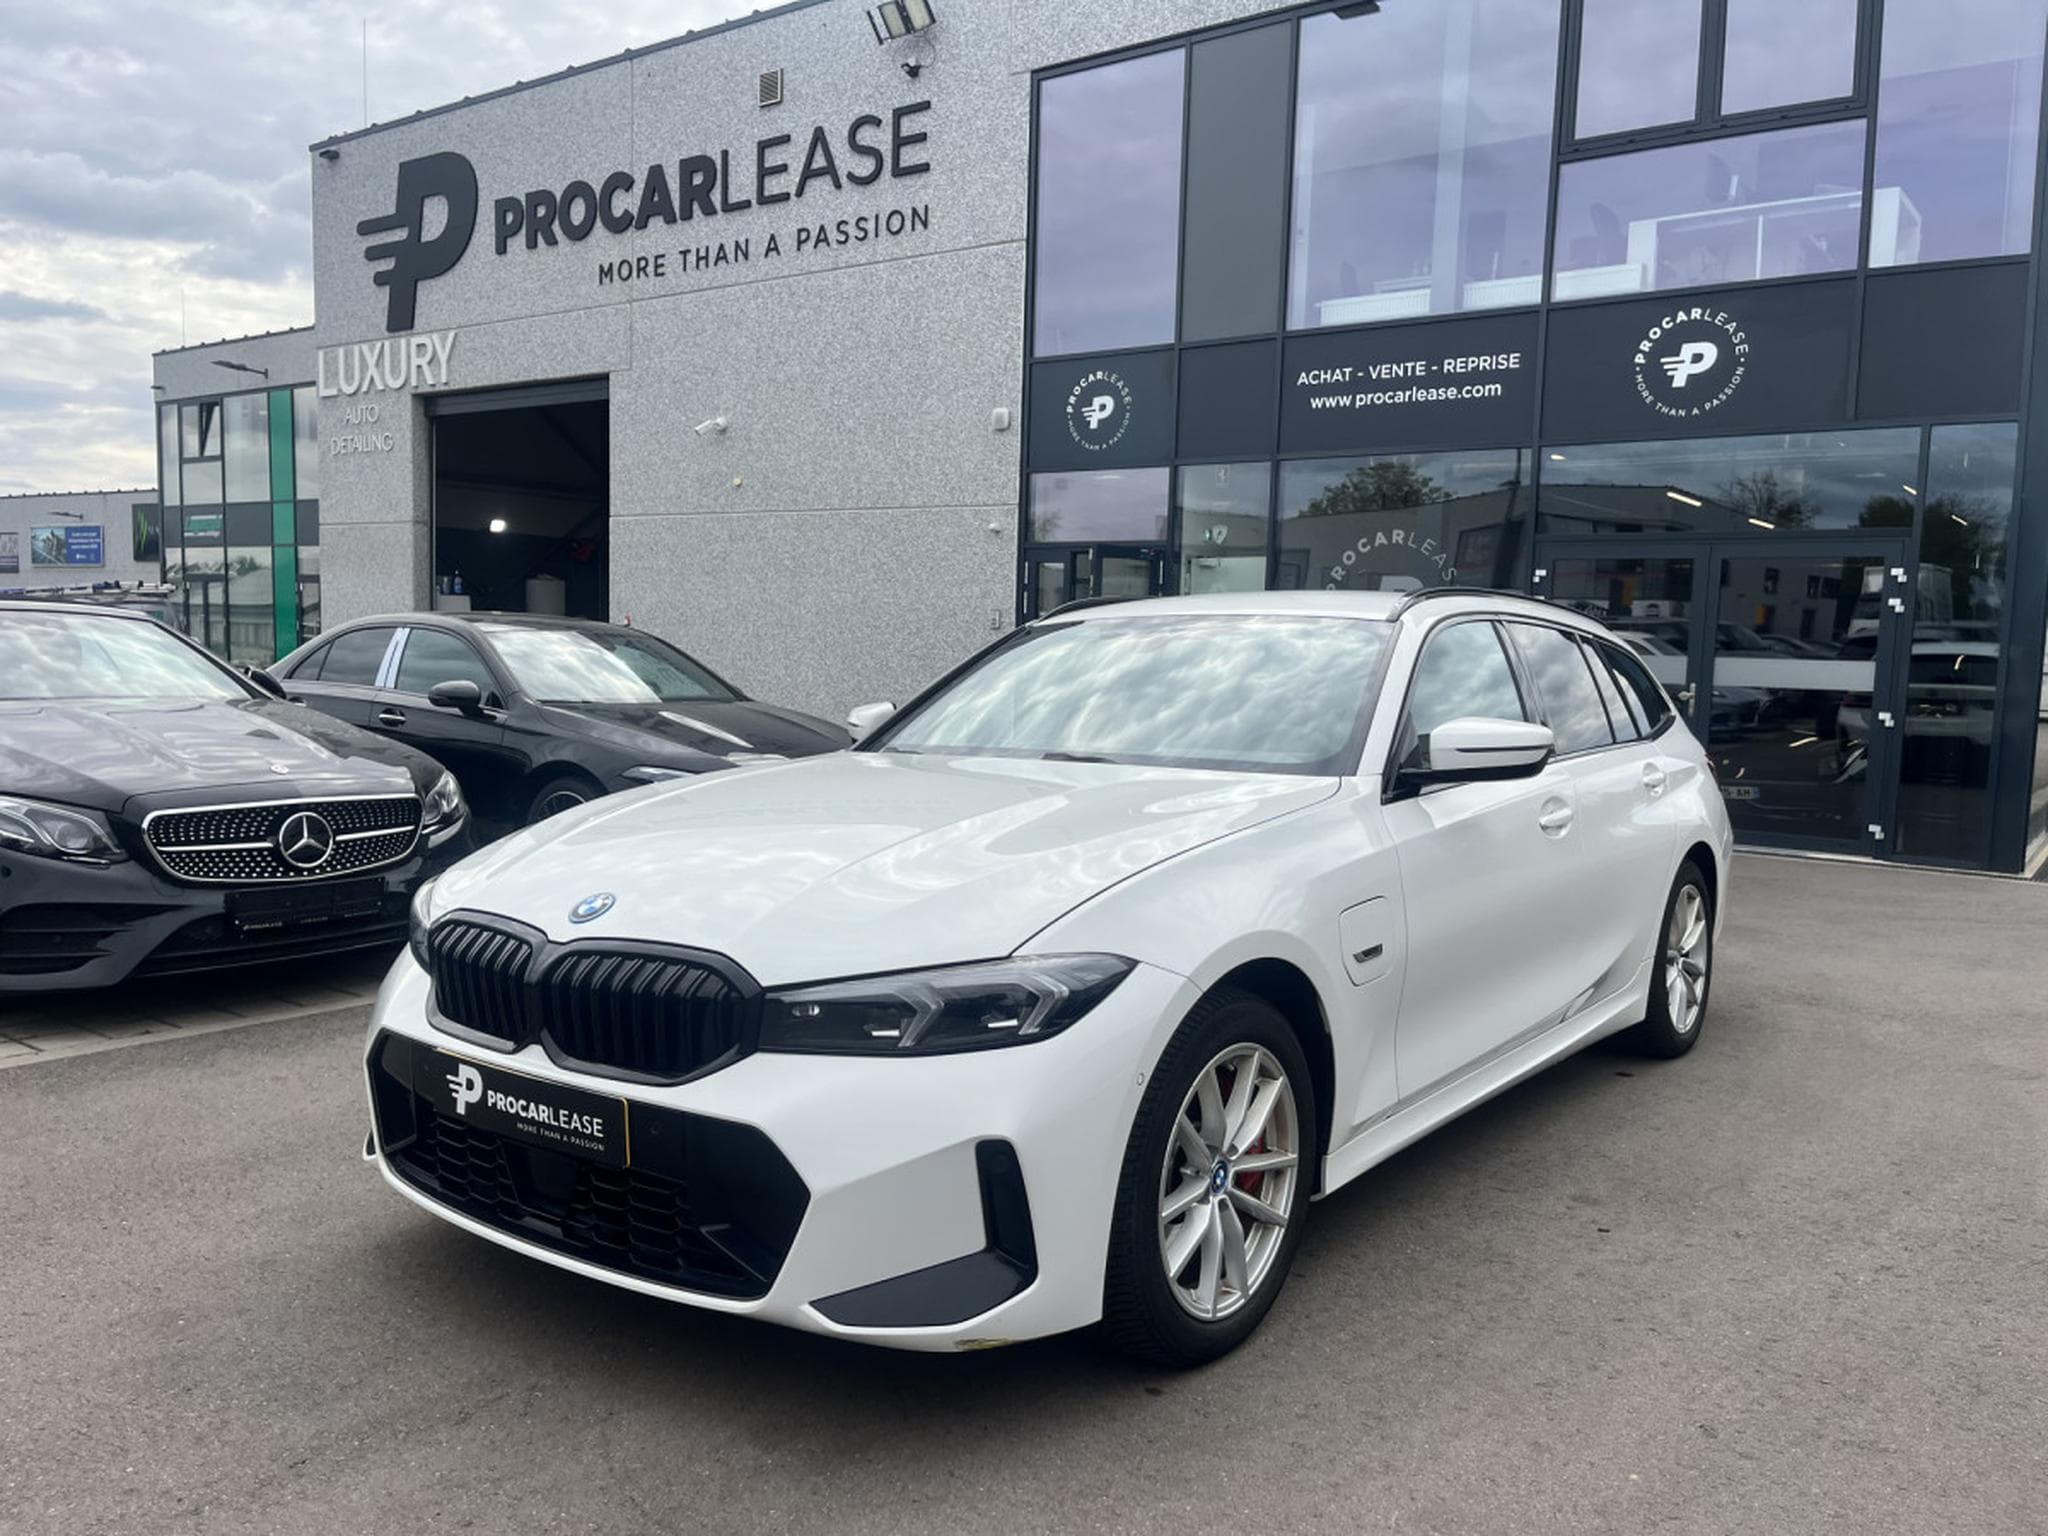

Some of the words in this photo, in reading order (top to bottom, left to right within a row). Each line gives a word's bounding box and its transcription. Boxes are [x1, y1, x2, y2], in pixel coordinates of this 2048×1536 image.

[495, 100, 931, 255] PROCARLEASE
[599, 254, 666, 286] MORE
[679, 238, 750, 272] THAN
[764, 233, 781, 259] A
[796, 204, 930, 251] PASSION
[1634, 307, 1749, 364] PROCARLEASE
[318, 331, 458, 398] LUXURY
[1297, 367, 1353, 386] ACHAT
[1369, 361, 1427, 380] VENTE
[1443, 353, 1521, 374] REPRISE
[344, 403, 380, 424] AUTO
[1066, 370, 1132, 413] PROCARLEASE
[1635, 374, 1655, 404] MORE
[1655, 402, 1686, 417] THAN
[1692, 407, 1700, 416] A
[1704, 366, 1745, 411] PASSION
[330, 432, 394, 456] DETAILING
[487, 1090, 604, 1138] PROCARLEASE
[516, 1121, 538, 1135] MORE
[540, 1128, 561, 1142] THAN
[570, 1136, 606, 1151] PASSION
